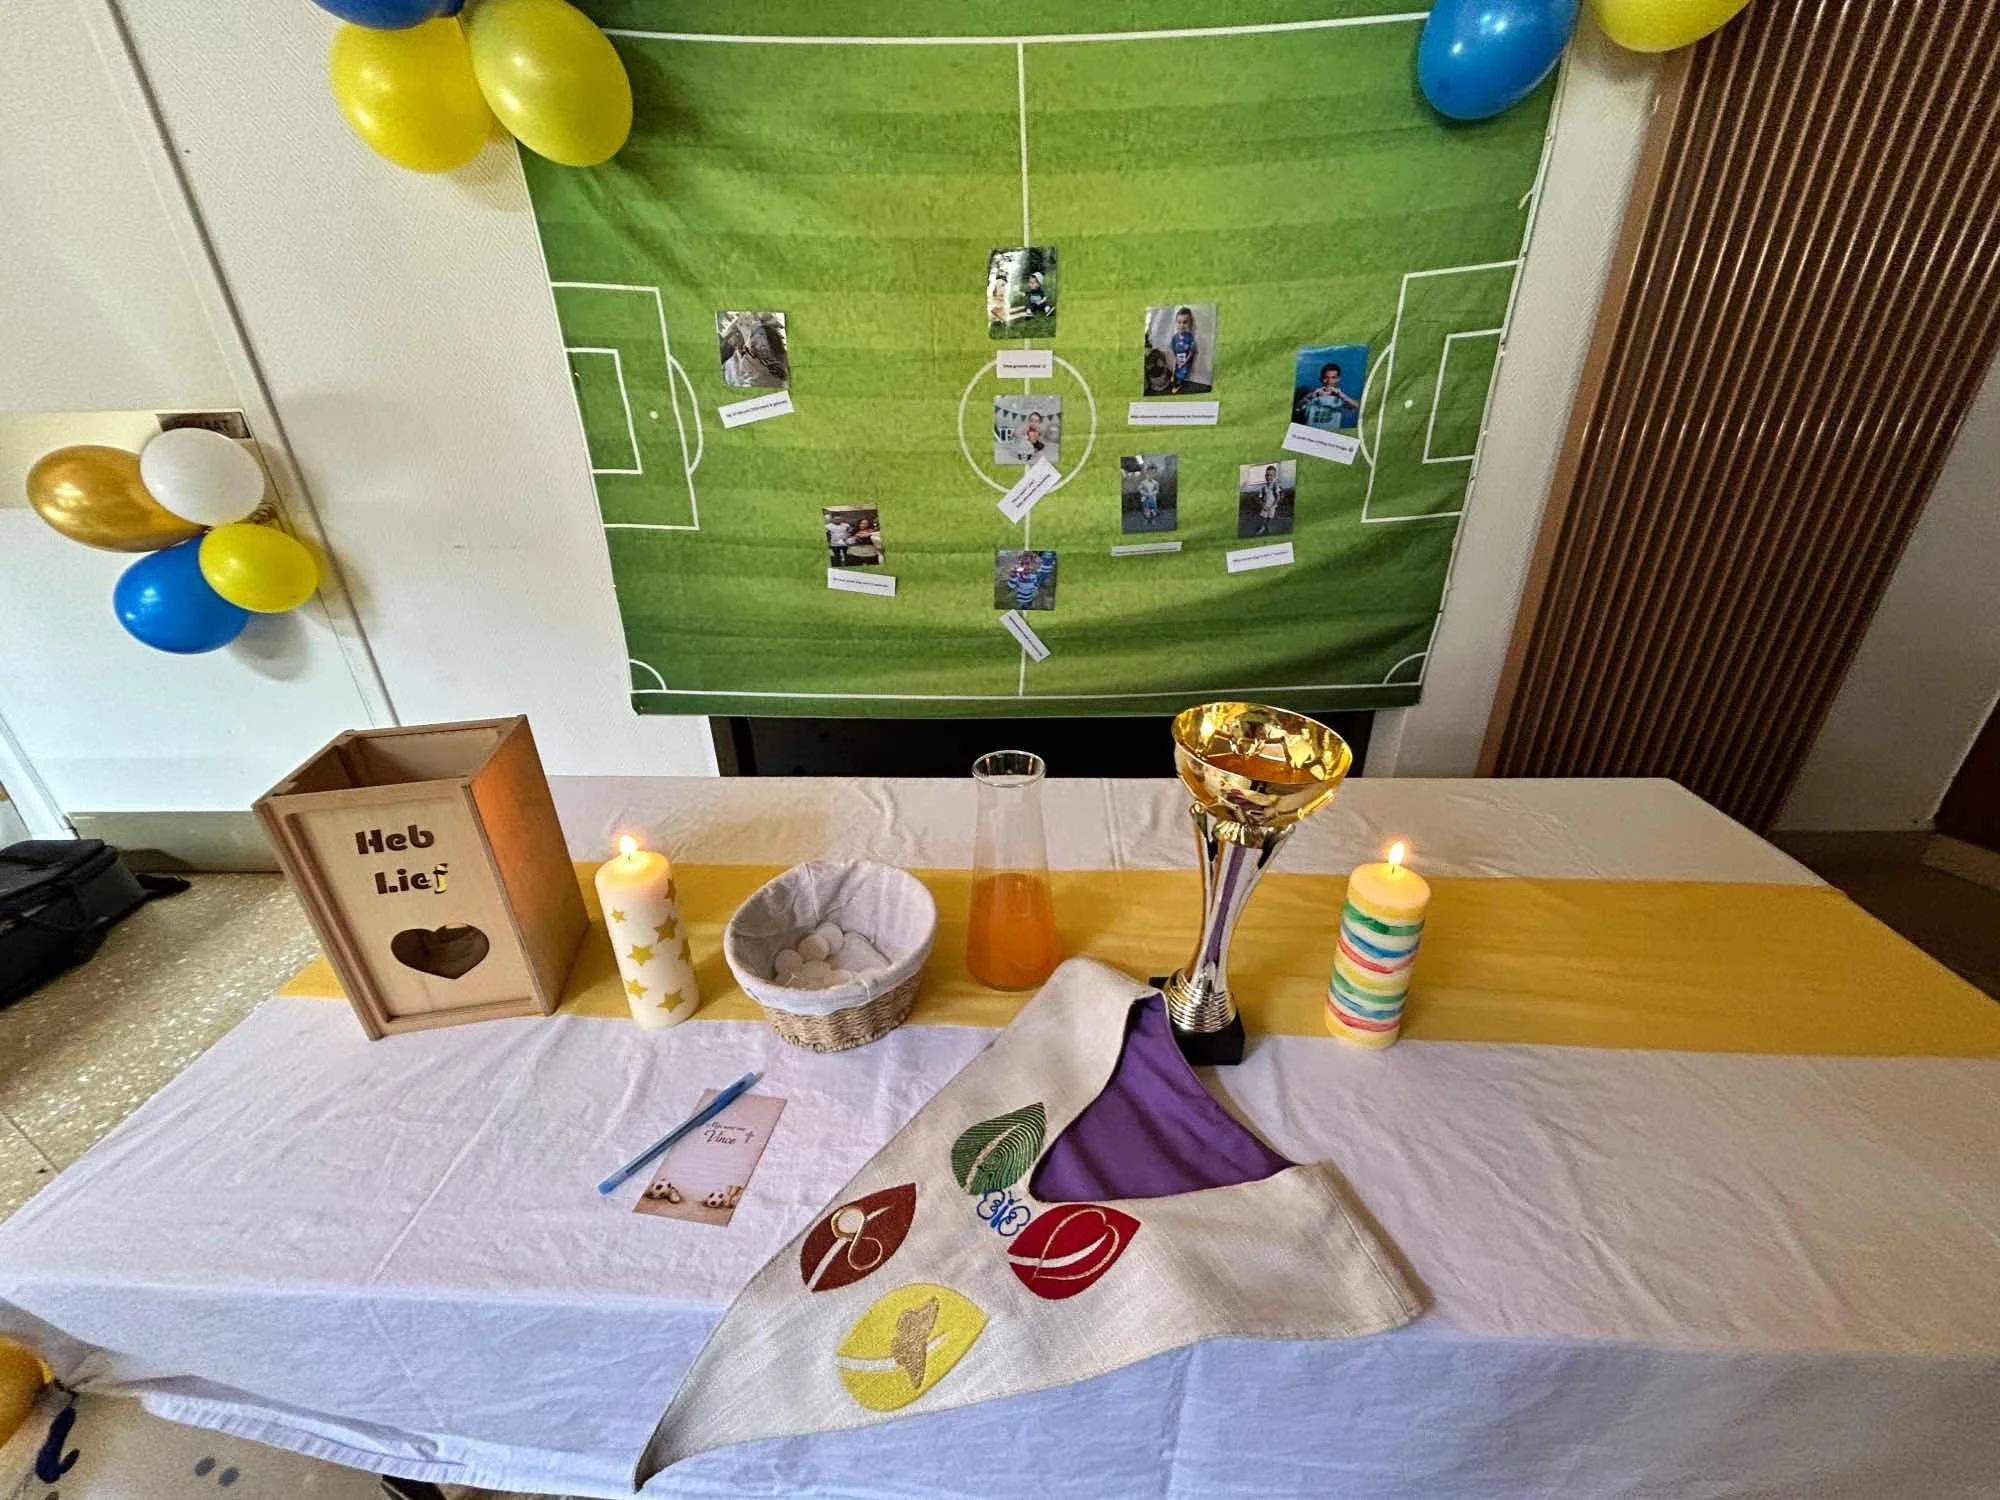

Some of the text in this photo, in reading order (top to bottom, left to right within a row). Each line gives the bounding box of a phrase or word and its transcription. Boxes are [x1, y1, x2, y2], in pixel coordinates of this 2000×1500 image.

[355, 824, 435, 855] Heb
[374, 862, 449, 894] Lief
[704, 1129, 737, 1145] Vince
